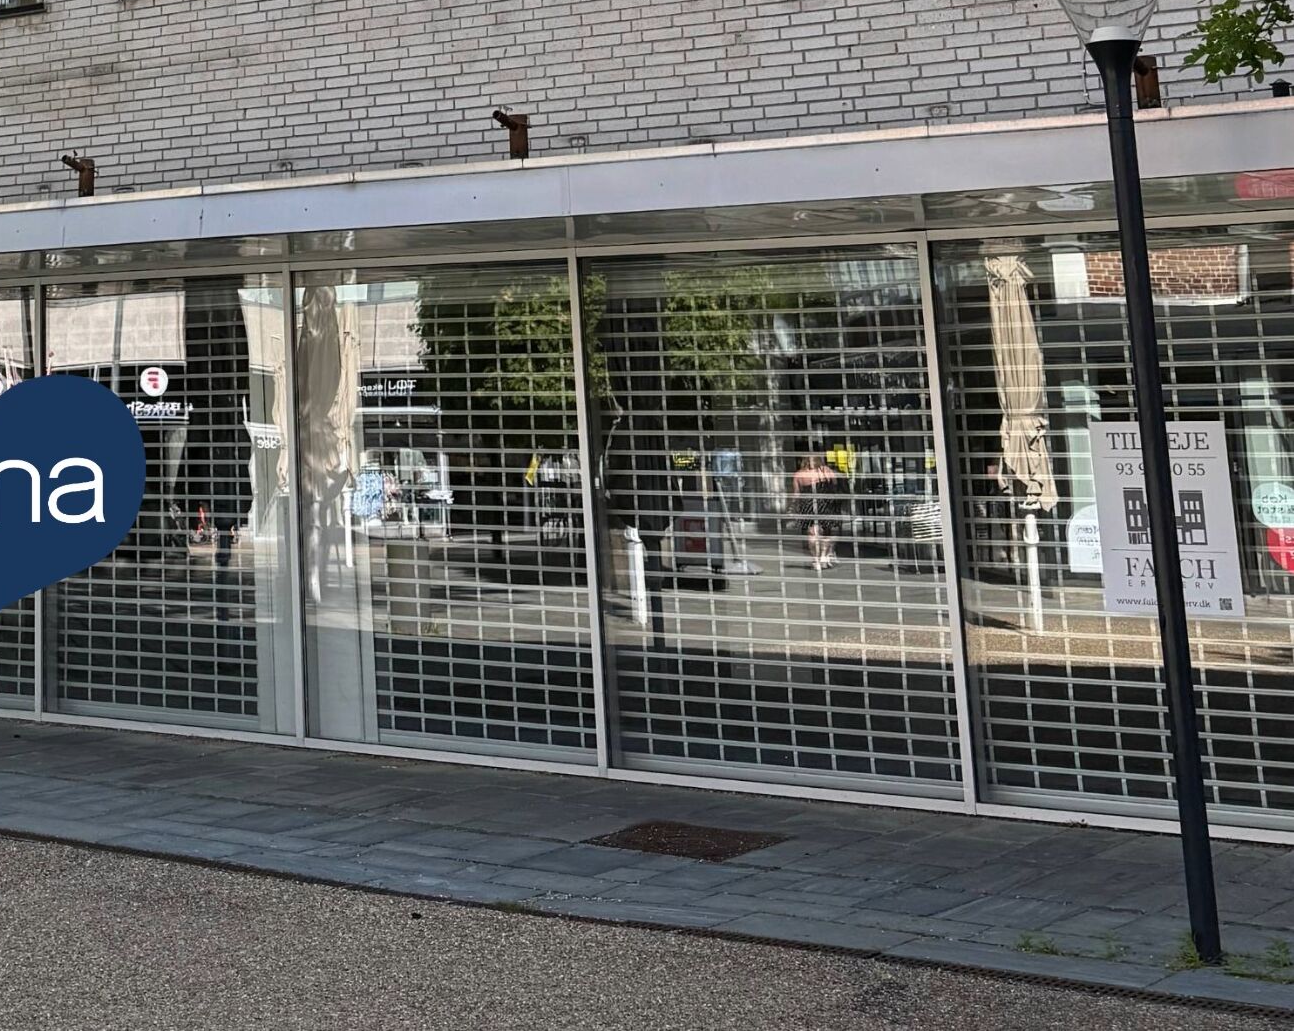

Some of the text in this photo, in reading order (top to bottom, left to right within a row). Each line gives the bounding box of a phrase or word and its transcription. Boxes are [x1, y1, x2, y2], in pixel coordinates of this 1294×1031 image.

[1106, 432, 1210, 450] TIL EJE
[1115, 462, 1134, 476] 93
[1188, 463, 1206, 476] 55
[1124, 557, 1218, 580] FACH
